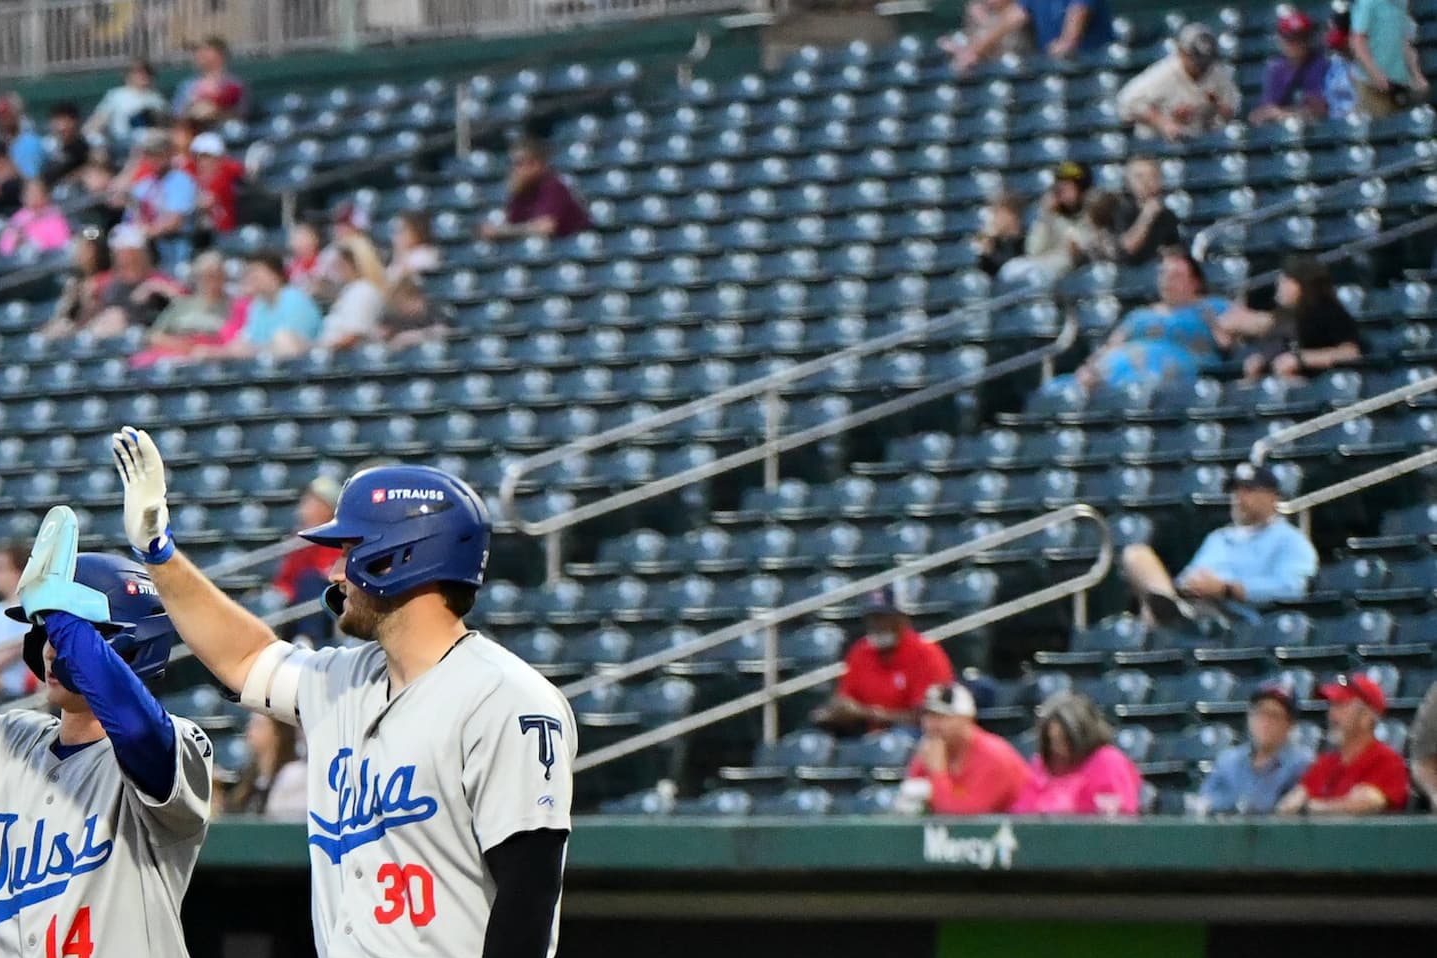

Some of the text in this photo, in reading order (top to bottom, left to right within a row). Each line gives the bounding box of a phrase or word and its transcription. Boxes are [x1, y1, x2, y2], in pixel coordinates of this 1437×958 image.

[387, 488, 444, 501] STRAUSS
[309, 747, 438, 842] Tulsa
[373, 863, 437, 927] 30
